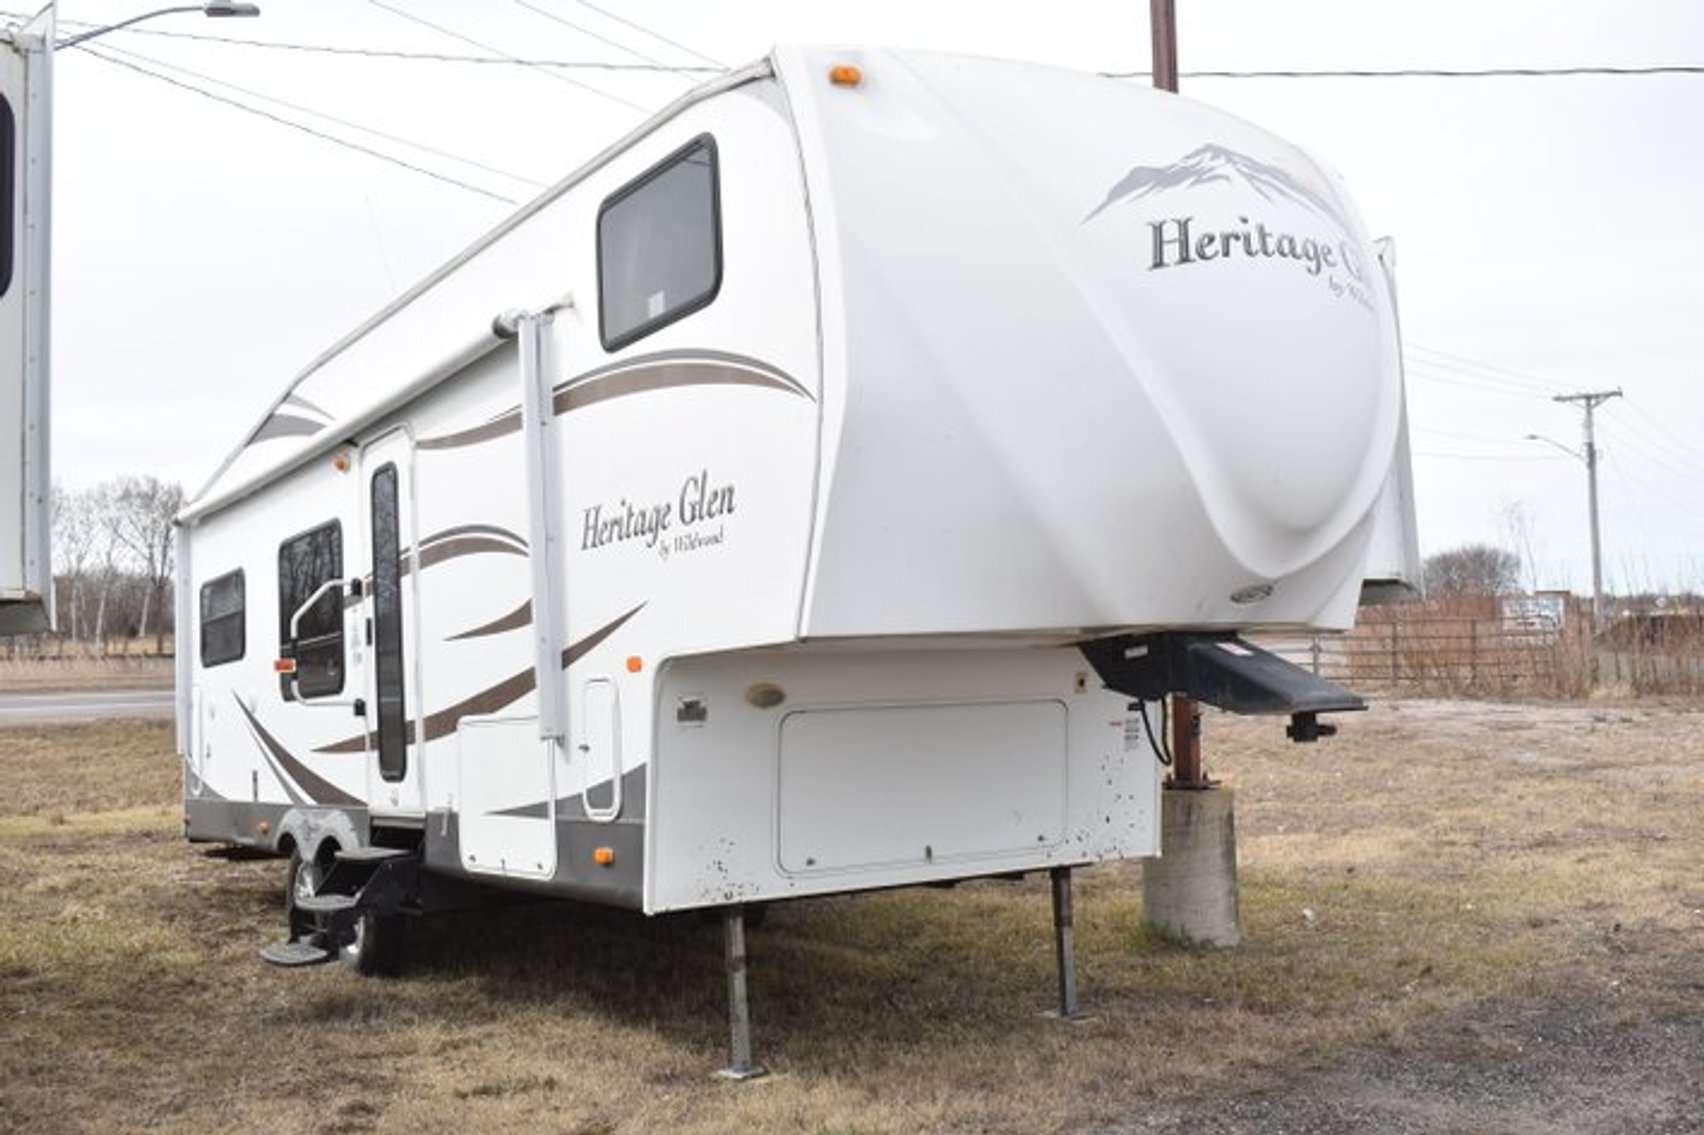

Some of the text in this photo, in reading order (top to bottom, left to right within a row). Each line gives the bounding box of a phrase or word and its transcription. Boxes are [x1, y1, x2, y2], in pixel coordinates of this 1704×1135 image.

[1147, 216, 1337, 276] Heritage
[581, 468, 735, 551] Heritage Glen
